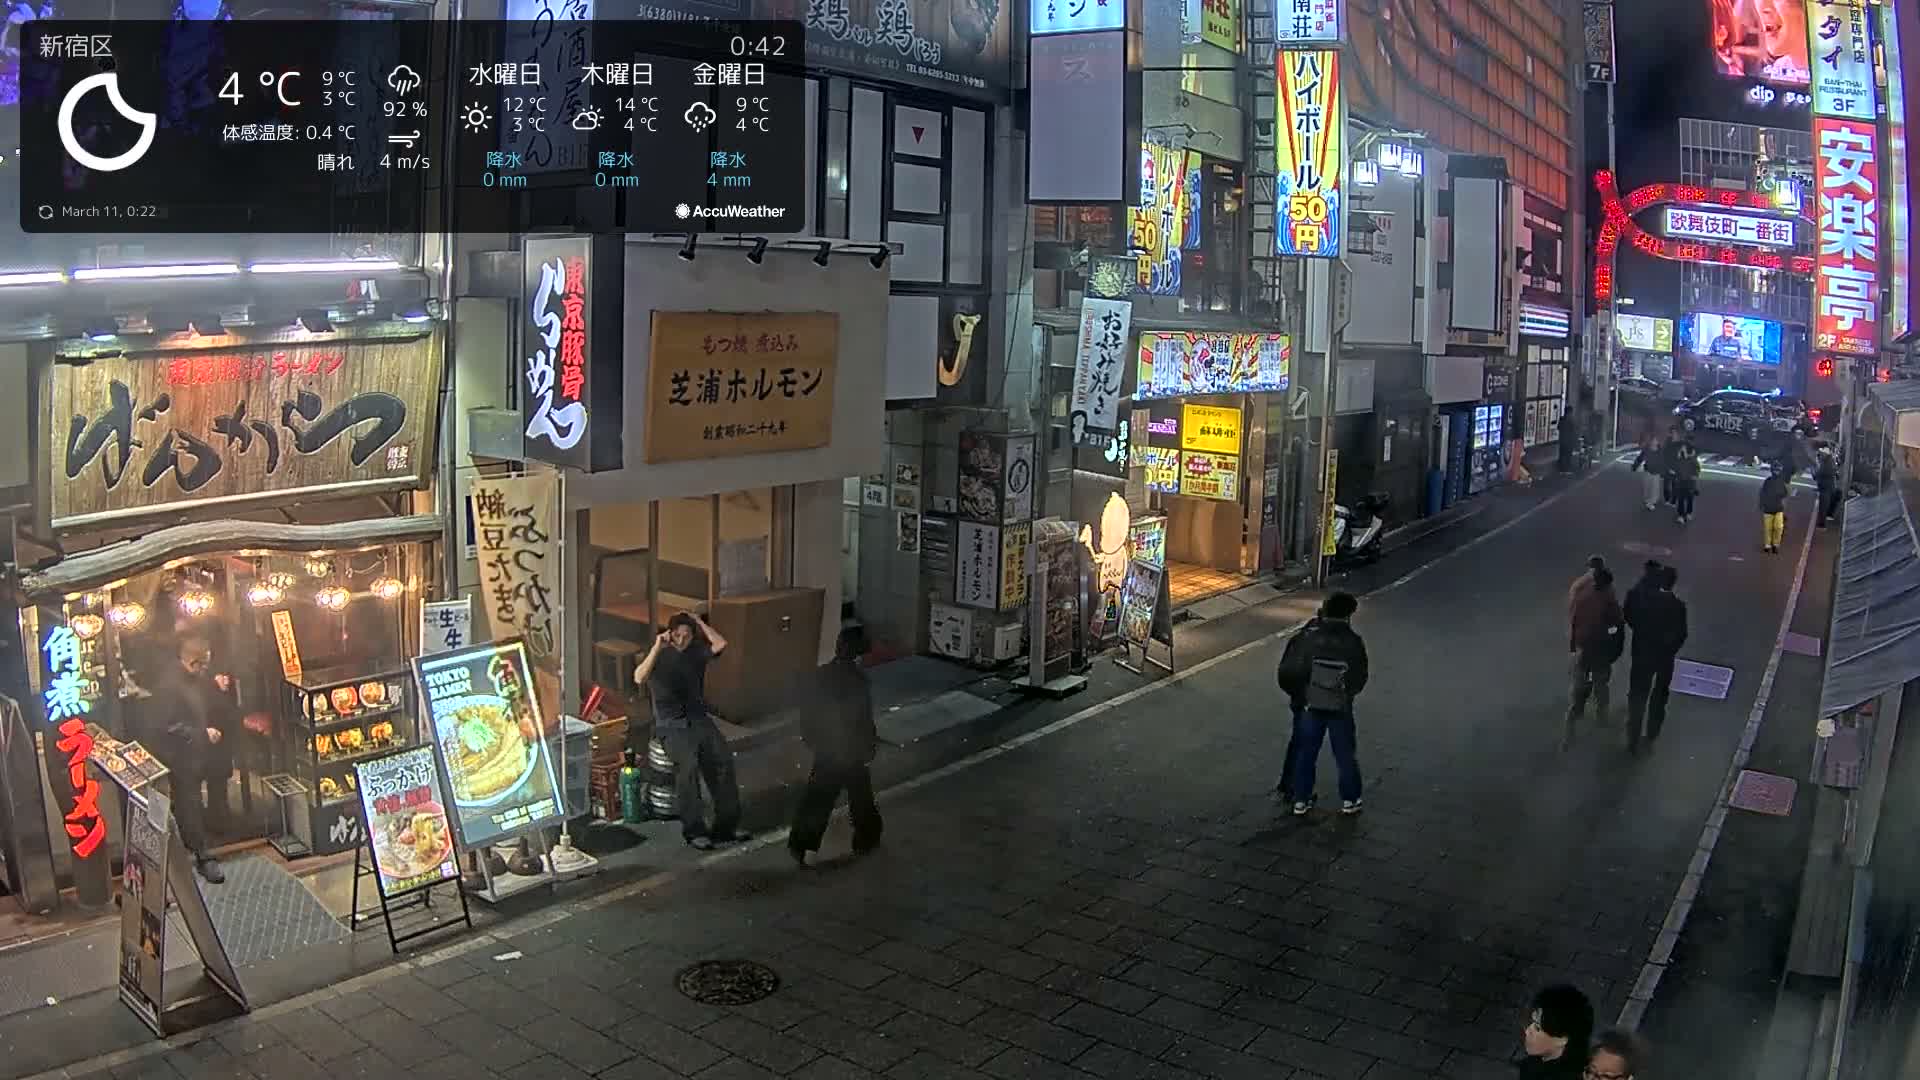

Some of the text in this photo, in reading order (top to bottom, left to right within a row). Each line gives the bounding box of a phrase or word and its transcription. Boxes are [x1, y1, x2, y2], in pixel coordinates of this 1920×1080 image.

[1590, 64, 1609, 79] 7F
[1750, 85, 1774, 102] dip
[1833, 98, 1856, 112] 3F
[1296, 55, 1321, 190] ハイボール
[1160, 153, 1176, 288] ハイボール
[1670, 211, 1789, 242] 歌舞伎町一番街
[1819, 126, 1876, 331] 安楽亭
[562, 257, 584, 400] 東京豚骨
[1089, 309, 1122, 416] お好み焼き
[669, 367, 823, 406] 芝浦ホルモン
[65, 377, 408, 496] ばんから
[42, 625, 90, 722] 角煮
[426, 666, 470, 686] TOKYO
[429, 679, 472, 700] RAMEN
[56, 718, 106, 858] ラーメン
[367, 763, 432, 797] ぶっかけ
